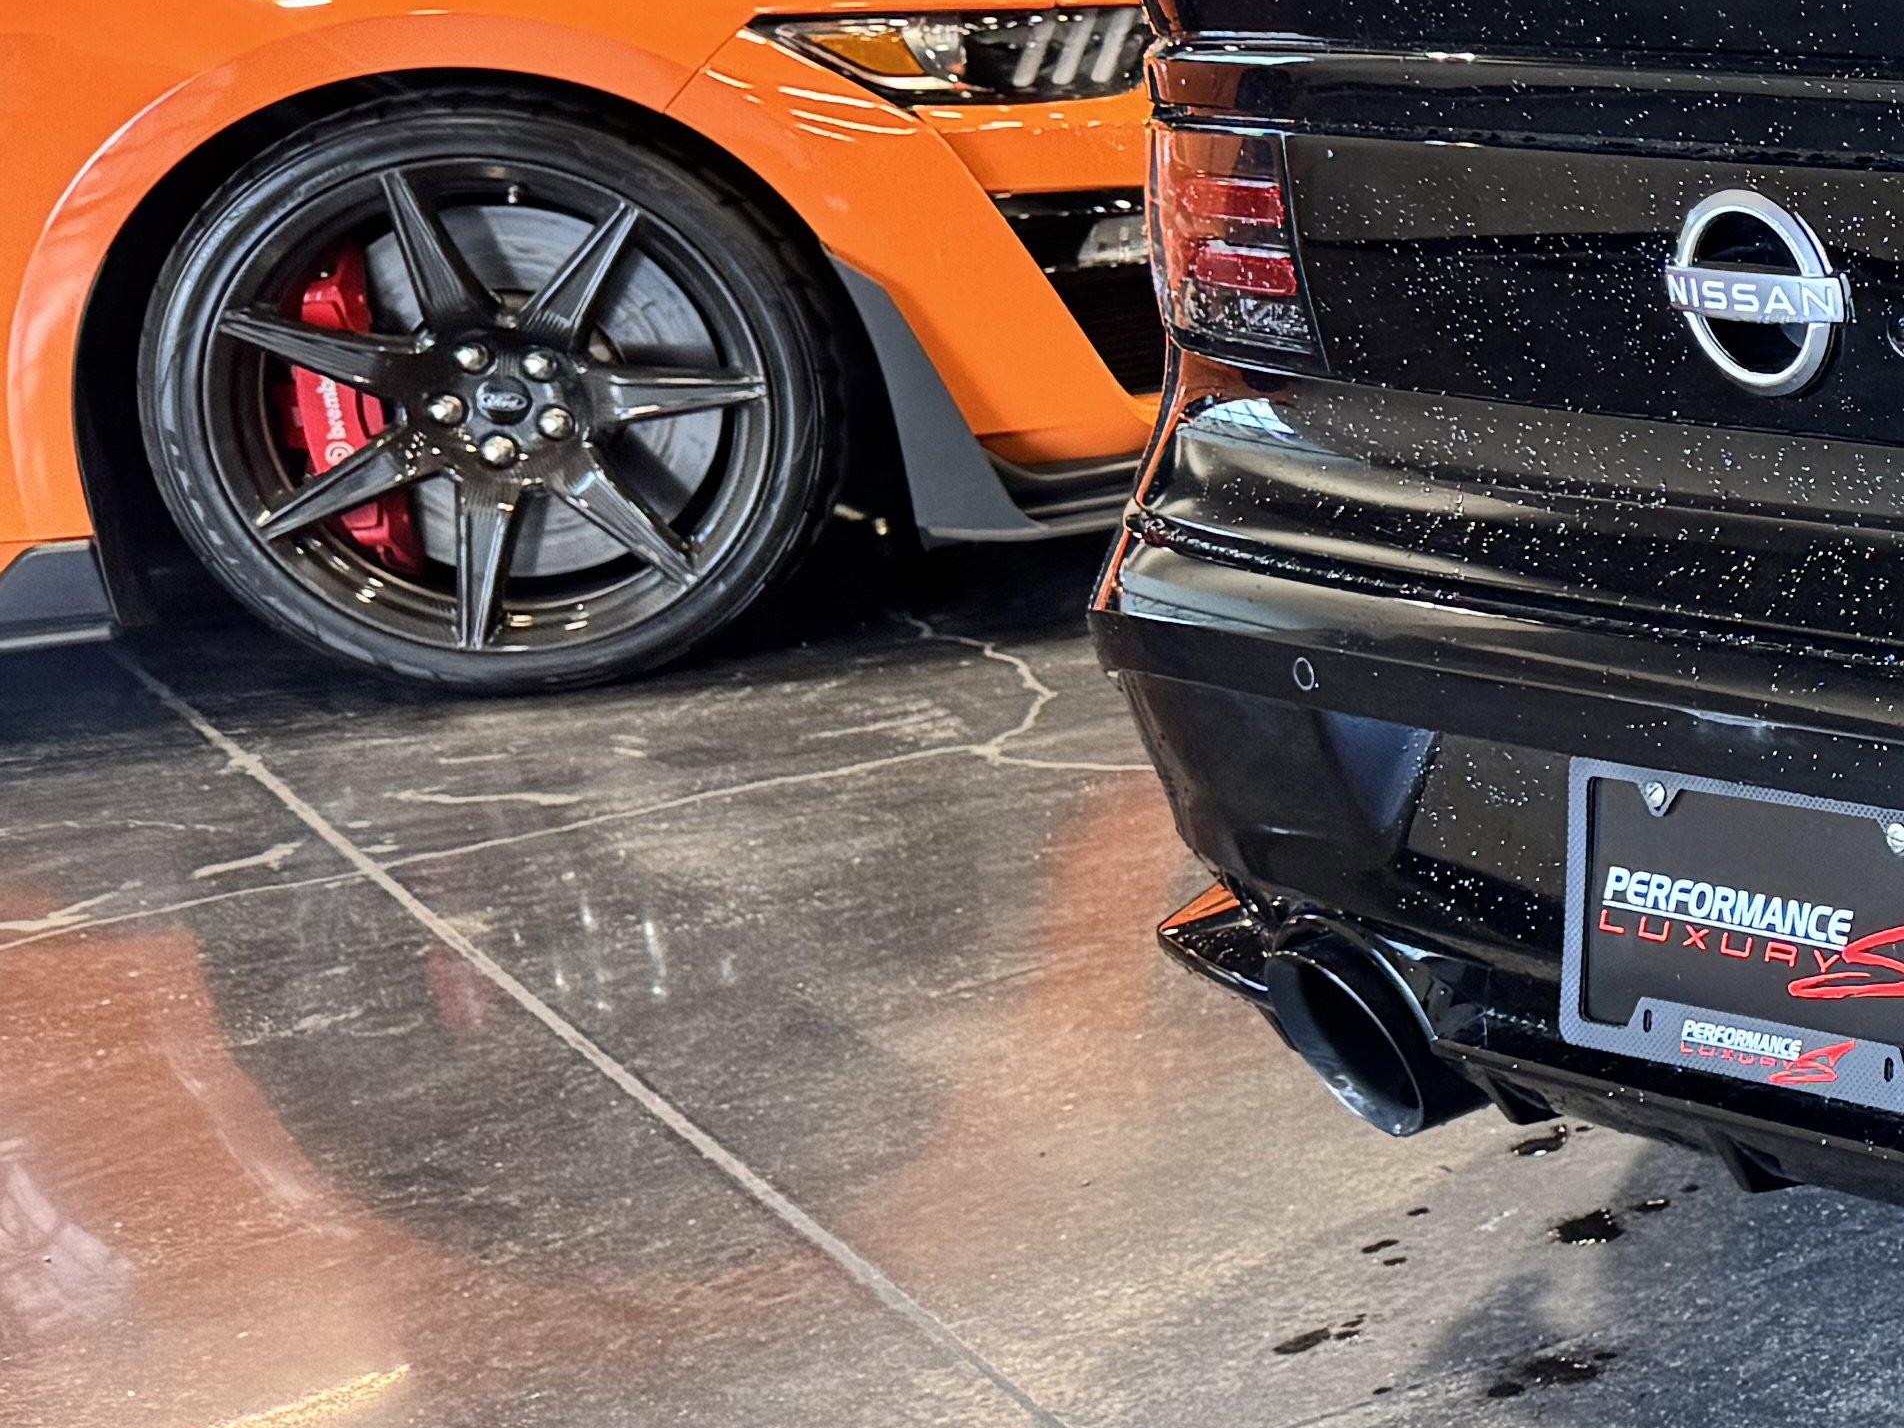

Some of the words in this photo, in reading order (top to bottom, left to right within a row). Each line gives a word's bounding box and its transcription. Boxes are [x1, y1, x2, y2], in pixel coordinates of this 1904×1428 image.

[1667, 274, 1836, 317] NISSAN
[316, 374, 346, 440] bremb
[1603, 865, 1854, 945] PERFORMANCE
[1599, 909, 1840, 973] LUXURY
[1679, 1040, 1796, 1070] LUXURY
[1682, 1019, 1802, 1056] PERFORMANCE
